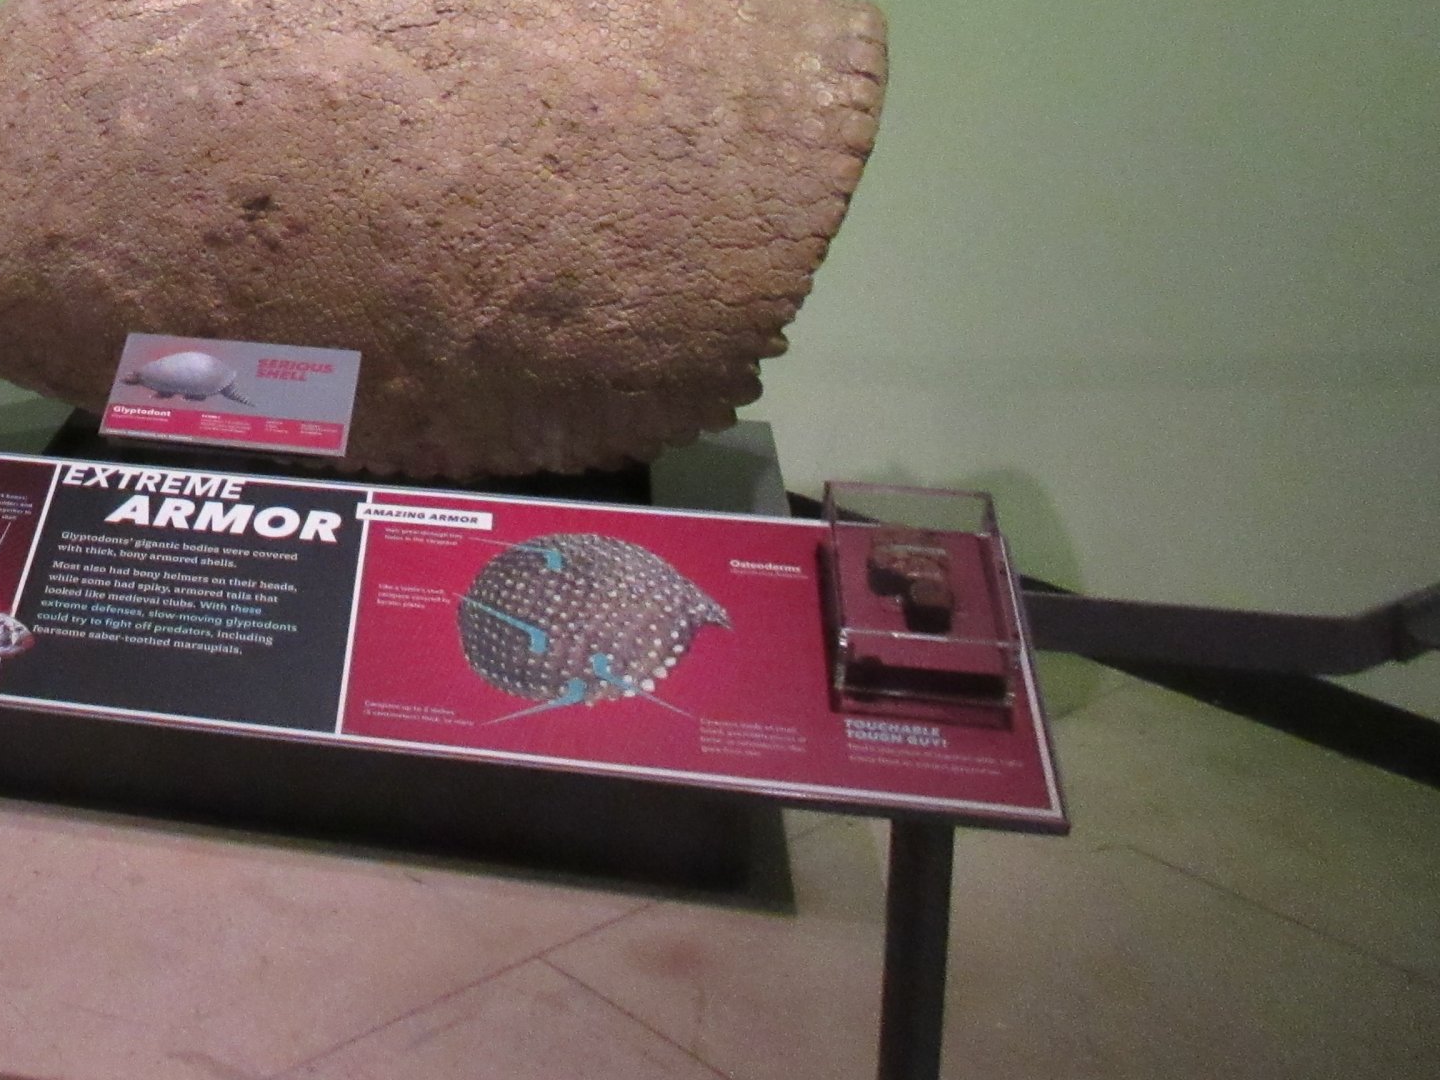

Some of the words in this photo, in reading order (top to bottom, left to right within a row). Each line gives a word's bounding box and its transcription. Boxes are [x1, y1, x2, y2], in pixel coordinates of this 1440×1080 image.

[113, 406, 171, 417] Glyptodont
[62, 464, 247, 500] EXTREME
[104, 494, 342, 543] ARMOR
[363, 508, 425, 519] AMAZING
[430, 513, 478, 524] ARMOR
[57, 543, 82, 553] with
[85, 546, 117, 557] thick,
[119, 549, 148, 561] bony
[149, 553, 198, 564] armored
[200, 557, 237, 568] shells.
[61, 531, 133, 545] Glyptodonts'
[134, 538, 180, 550] gigantic
[182, 542, 220, 554] bodies
[222, 547, 250, 556] were
[252, 550, 298, 561] covered
[52, 560, 81, 571] Most
[83, 564, 106, 573] also
[109, 565, 130, 575] had
[132, 568, 161, 580] bony
[162, 571, 209, 583] helmets
[211, 577, 226, 585] on
[229, 577, 257, 588] their
[259, 580, 297, 592] heads,
[730, 560, 801, 572] Osteoderms
[44, 585, 82, 597] looked
[84, 589, 106, 599] like
[107, 593, 160, 605] medieval
[162, 598, 196, 608] clubs.
[199, 600, 227, 611] With
[230, 603, 262, 615] these
[48, 573, 79, 583] while
[81, 577, 111, 587] some
[114, 579, 135, 589] had
[137, 583, 171, 594] spiky,
[173, 587, 223, 598] armored
[226, 591, 252, 600] tails
[254, 593, 278, 603] that
[36, 612, 69, 622] could
[71, 615, 87, 626] try
[90, 617, 102, 625] to
[105, 617, 132, 629] fight
[134, 621, 152, 630] off
[153, 625, 213, 638] predators,
[217, 630, 273, 646] including
[40, 599, 88, 611] extreme
[90, 603, 145, 617] defenses,
[148, 609, 222, 626] slow-moving
[225, 616, 297, 632] glyptodonts
[32, 624, 86, 638] fearsome
[88, 631, 171, 646] saber-toothed
[173, 640, 242, 655] marsupials.
